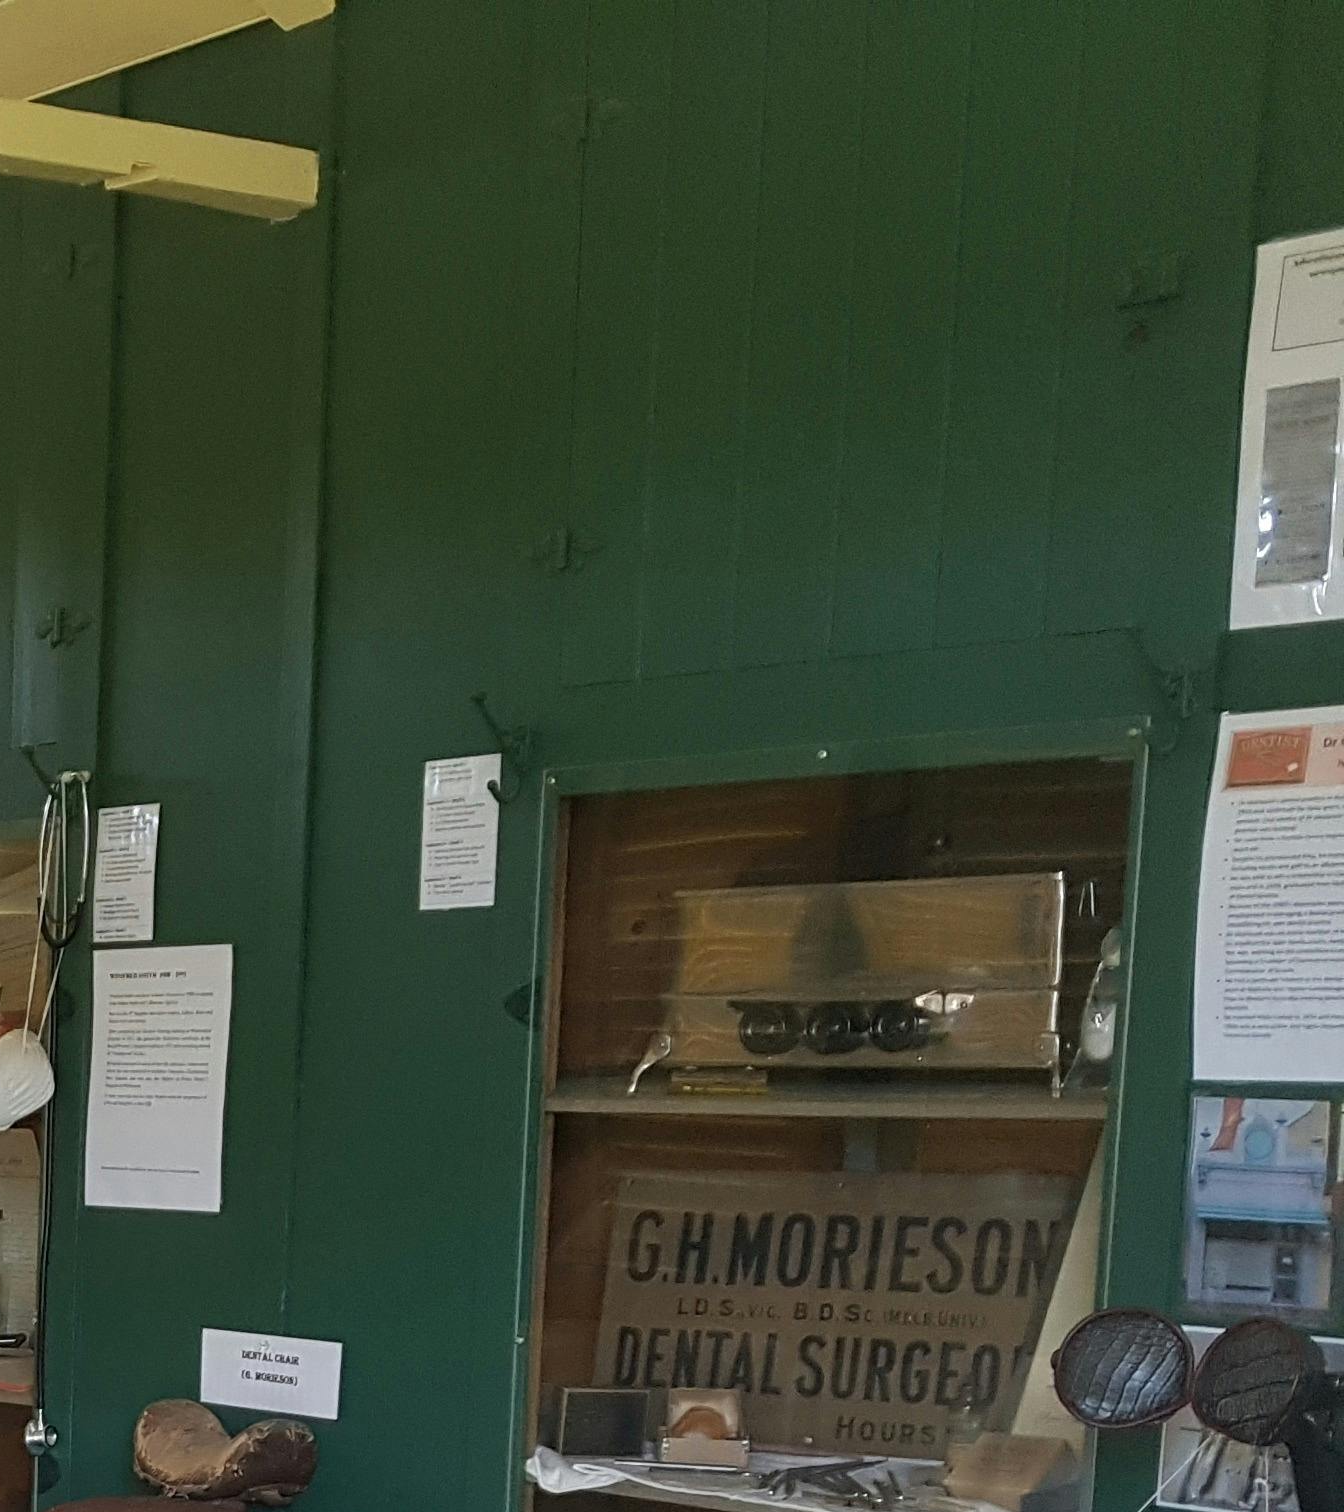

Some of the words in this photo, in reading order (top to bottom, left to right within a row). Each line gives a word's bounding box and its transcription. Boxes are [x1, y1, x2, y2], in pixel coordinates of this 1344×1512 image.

[627, 1211, 1060, 1297] G.H.MORIESON
[242, 1350, 273, 1362] DENTAL
[275, 1354, 299, 1366] CHAIR
[614, 1326, 782, 1394] DENTAL
